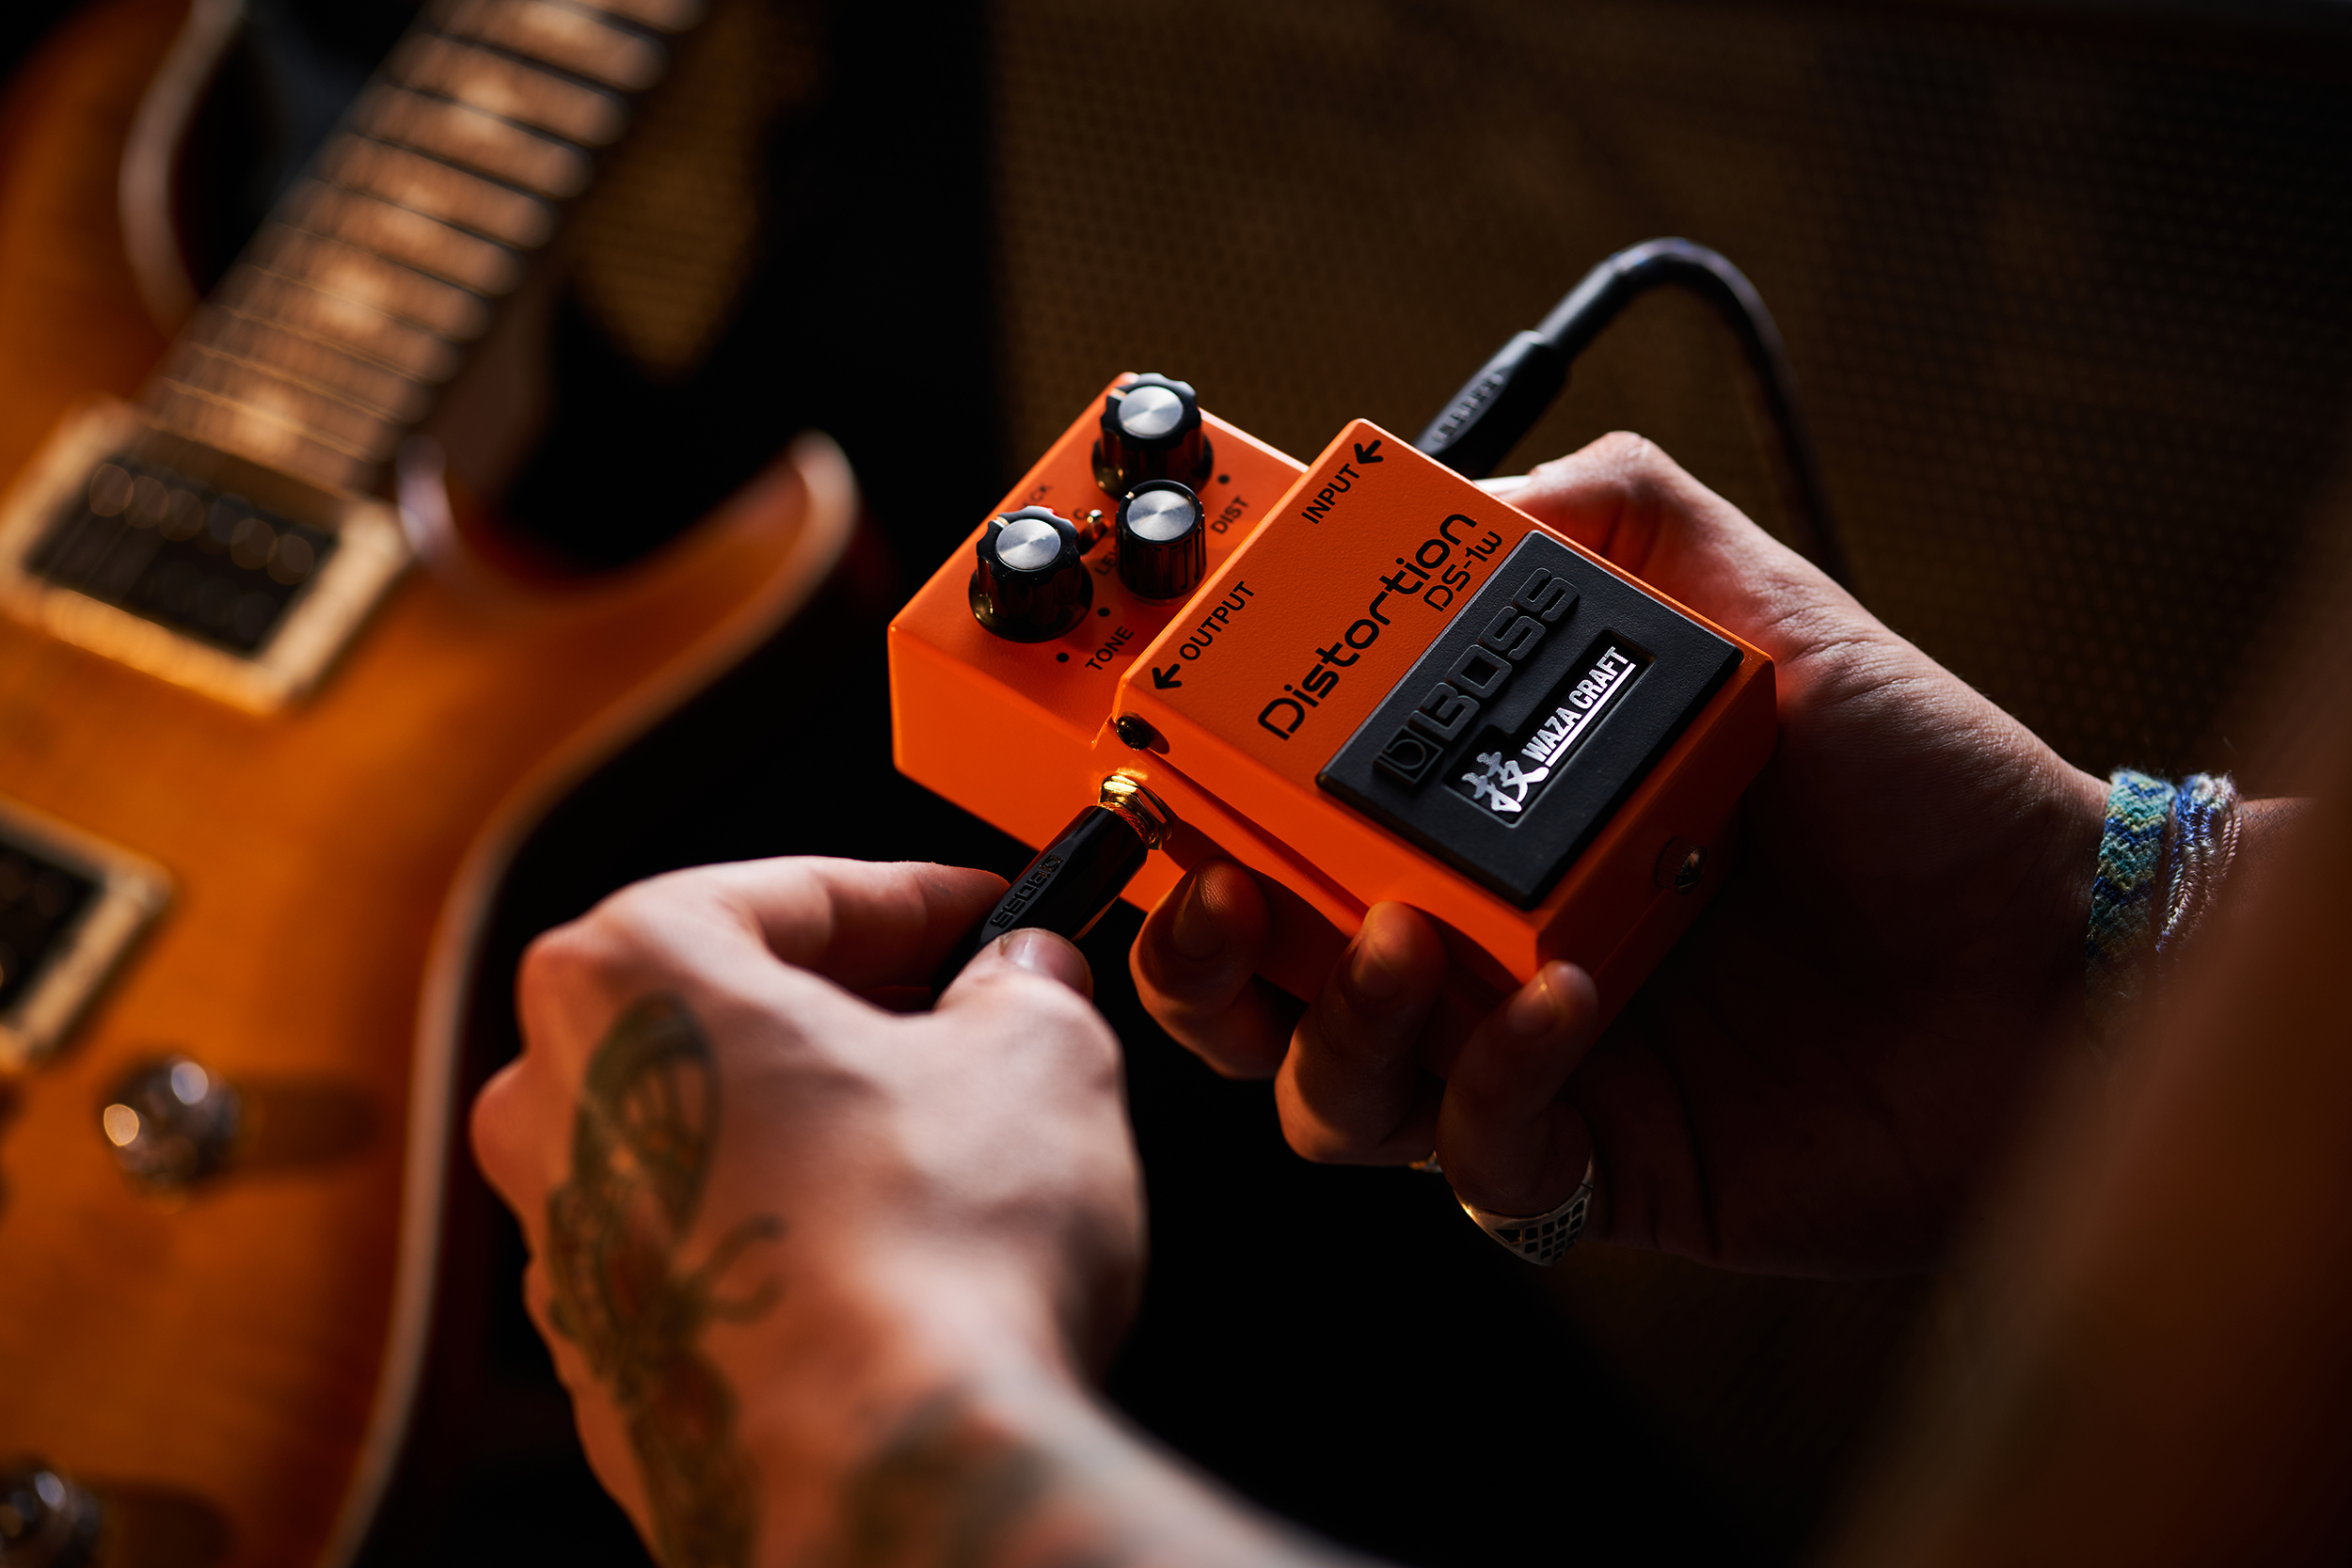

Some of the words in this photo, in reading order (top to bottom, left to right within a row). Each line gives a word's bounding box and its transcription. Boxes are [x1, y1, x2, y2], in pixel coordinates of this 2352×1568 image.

[1211, 496, 1248, 535] DIST
[1301, 464, 1359, 524] INPUT
[1085, 626, 1134, 672] TONE
[1179, 580, 1255, 661] OUTPUT
[1258, 513, 1477, 740] Distortion
[1521, 707, 1581, 762] WAZA
[1568, 646, 1629, 710] CRAFT
[1461, 751, 1549, 814] 技
